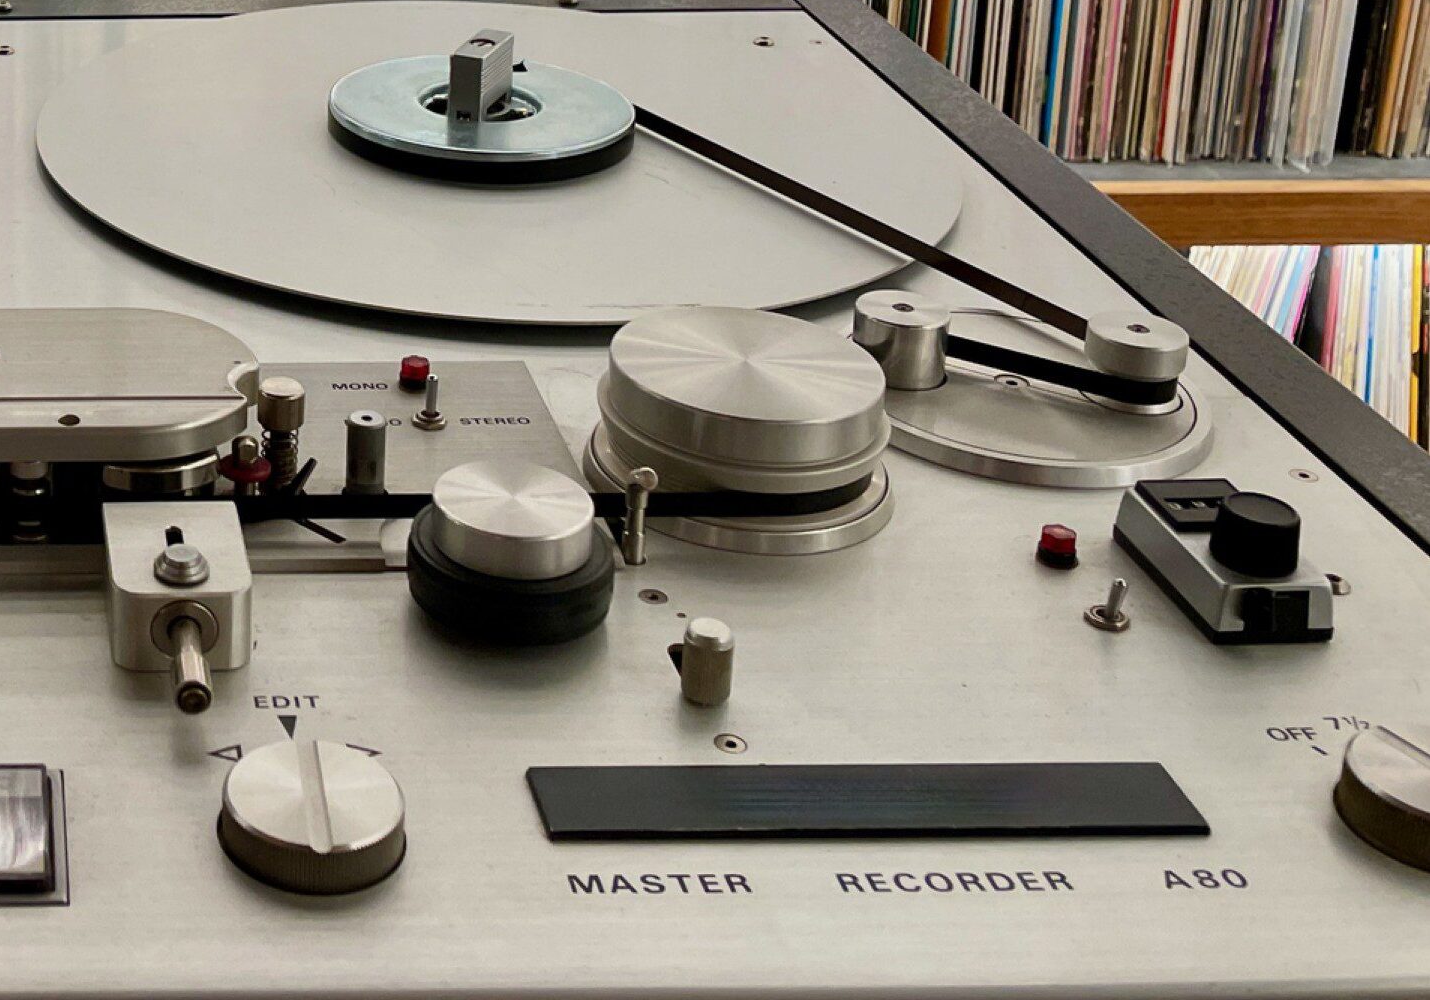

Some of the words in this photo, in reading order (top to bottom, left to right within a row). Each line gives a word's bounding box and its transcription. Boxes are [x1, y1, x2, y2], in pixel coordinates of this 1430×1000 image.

[332, 382, 389, 391] MONO
[459, 416, 531, 426] STEREO
[253, 695, 320, 709] EDIT
[1266, 726, 1318, 742] OFF
[567, 873, 753, 894] MASTER
[834, 870, 1075, 893] RECORDER
[1163, 868, 1249, 890] A80
